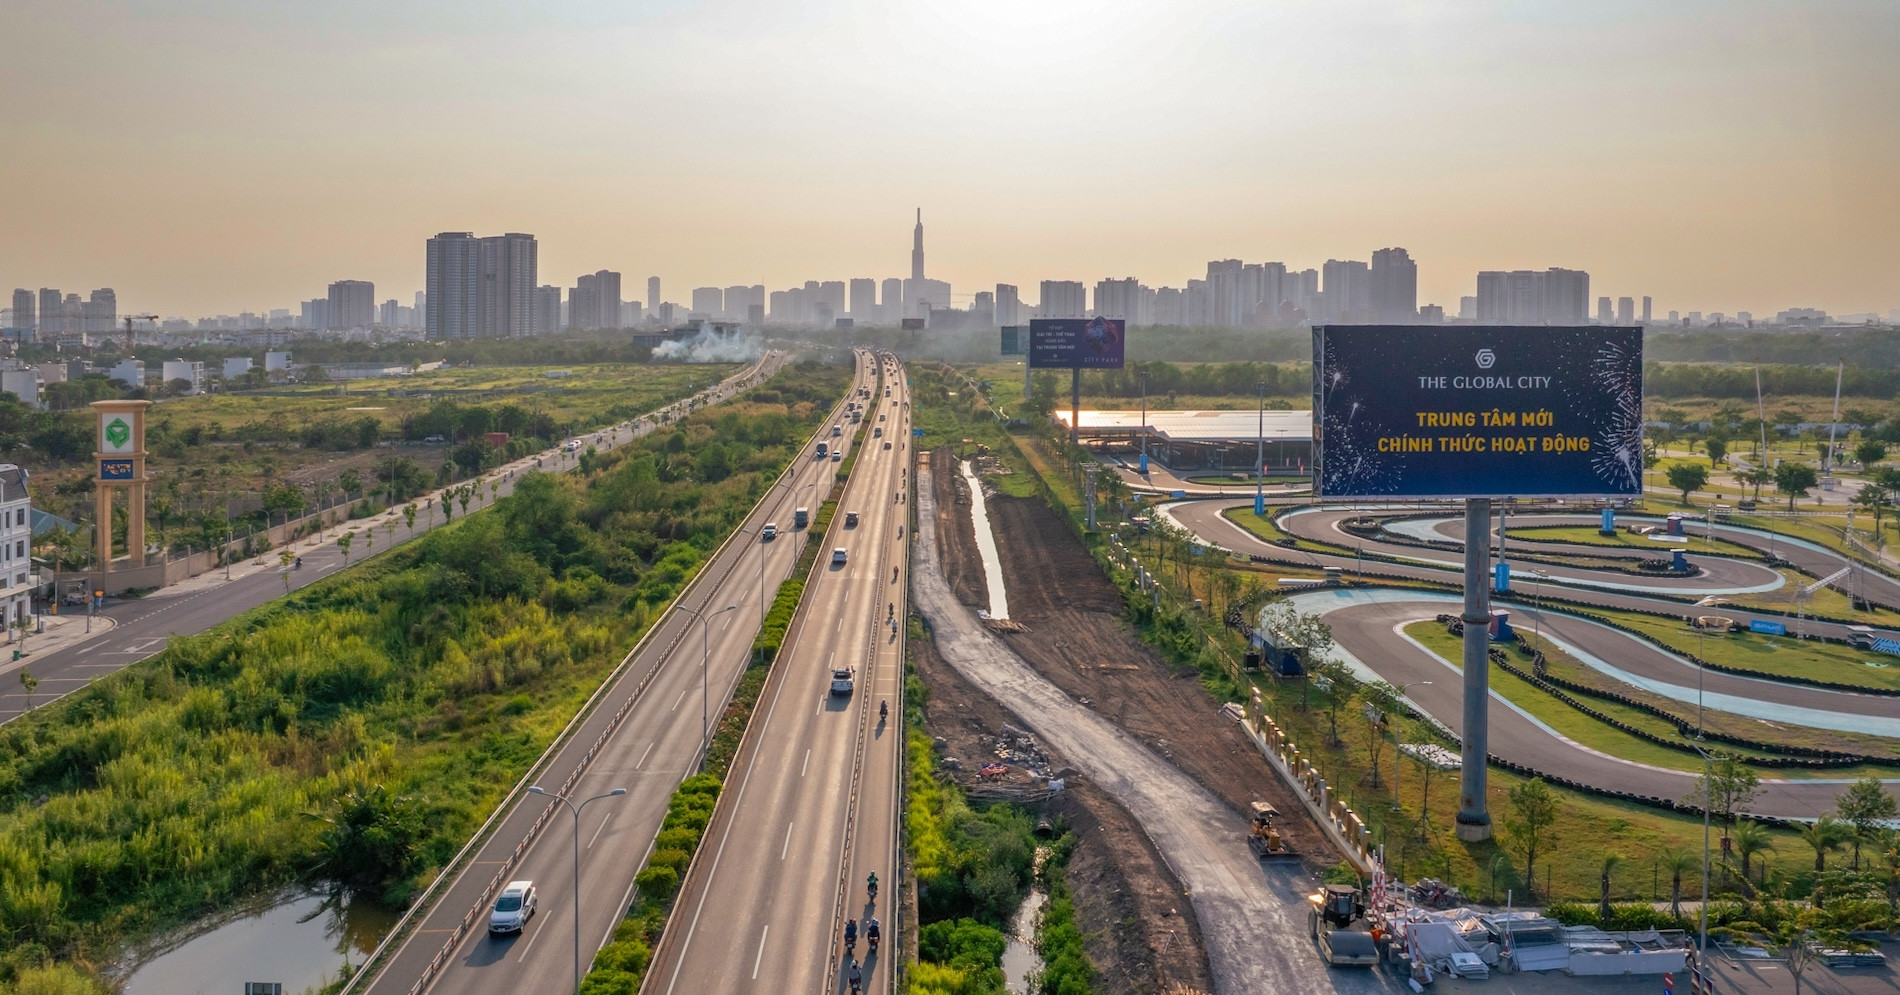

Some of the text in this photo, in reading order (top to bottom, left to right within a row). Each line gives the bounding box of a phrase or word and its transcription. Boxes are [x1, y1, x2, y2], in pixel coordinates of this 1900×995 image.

[1418, 376, 1551, 389] THE GLOBAL CITY
[1416, 408, 1553, 426] TRUNG TÂM MỚI
[1378, 434, 1590, 455] CHÍNH THỨC HOẠT ĐỘNG
